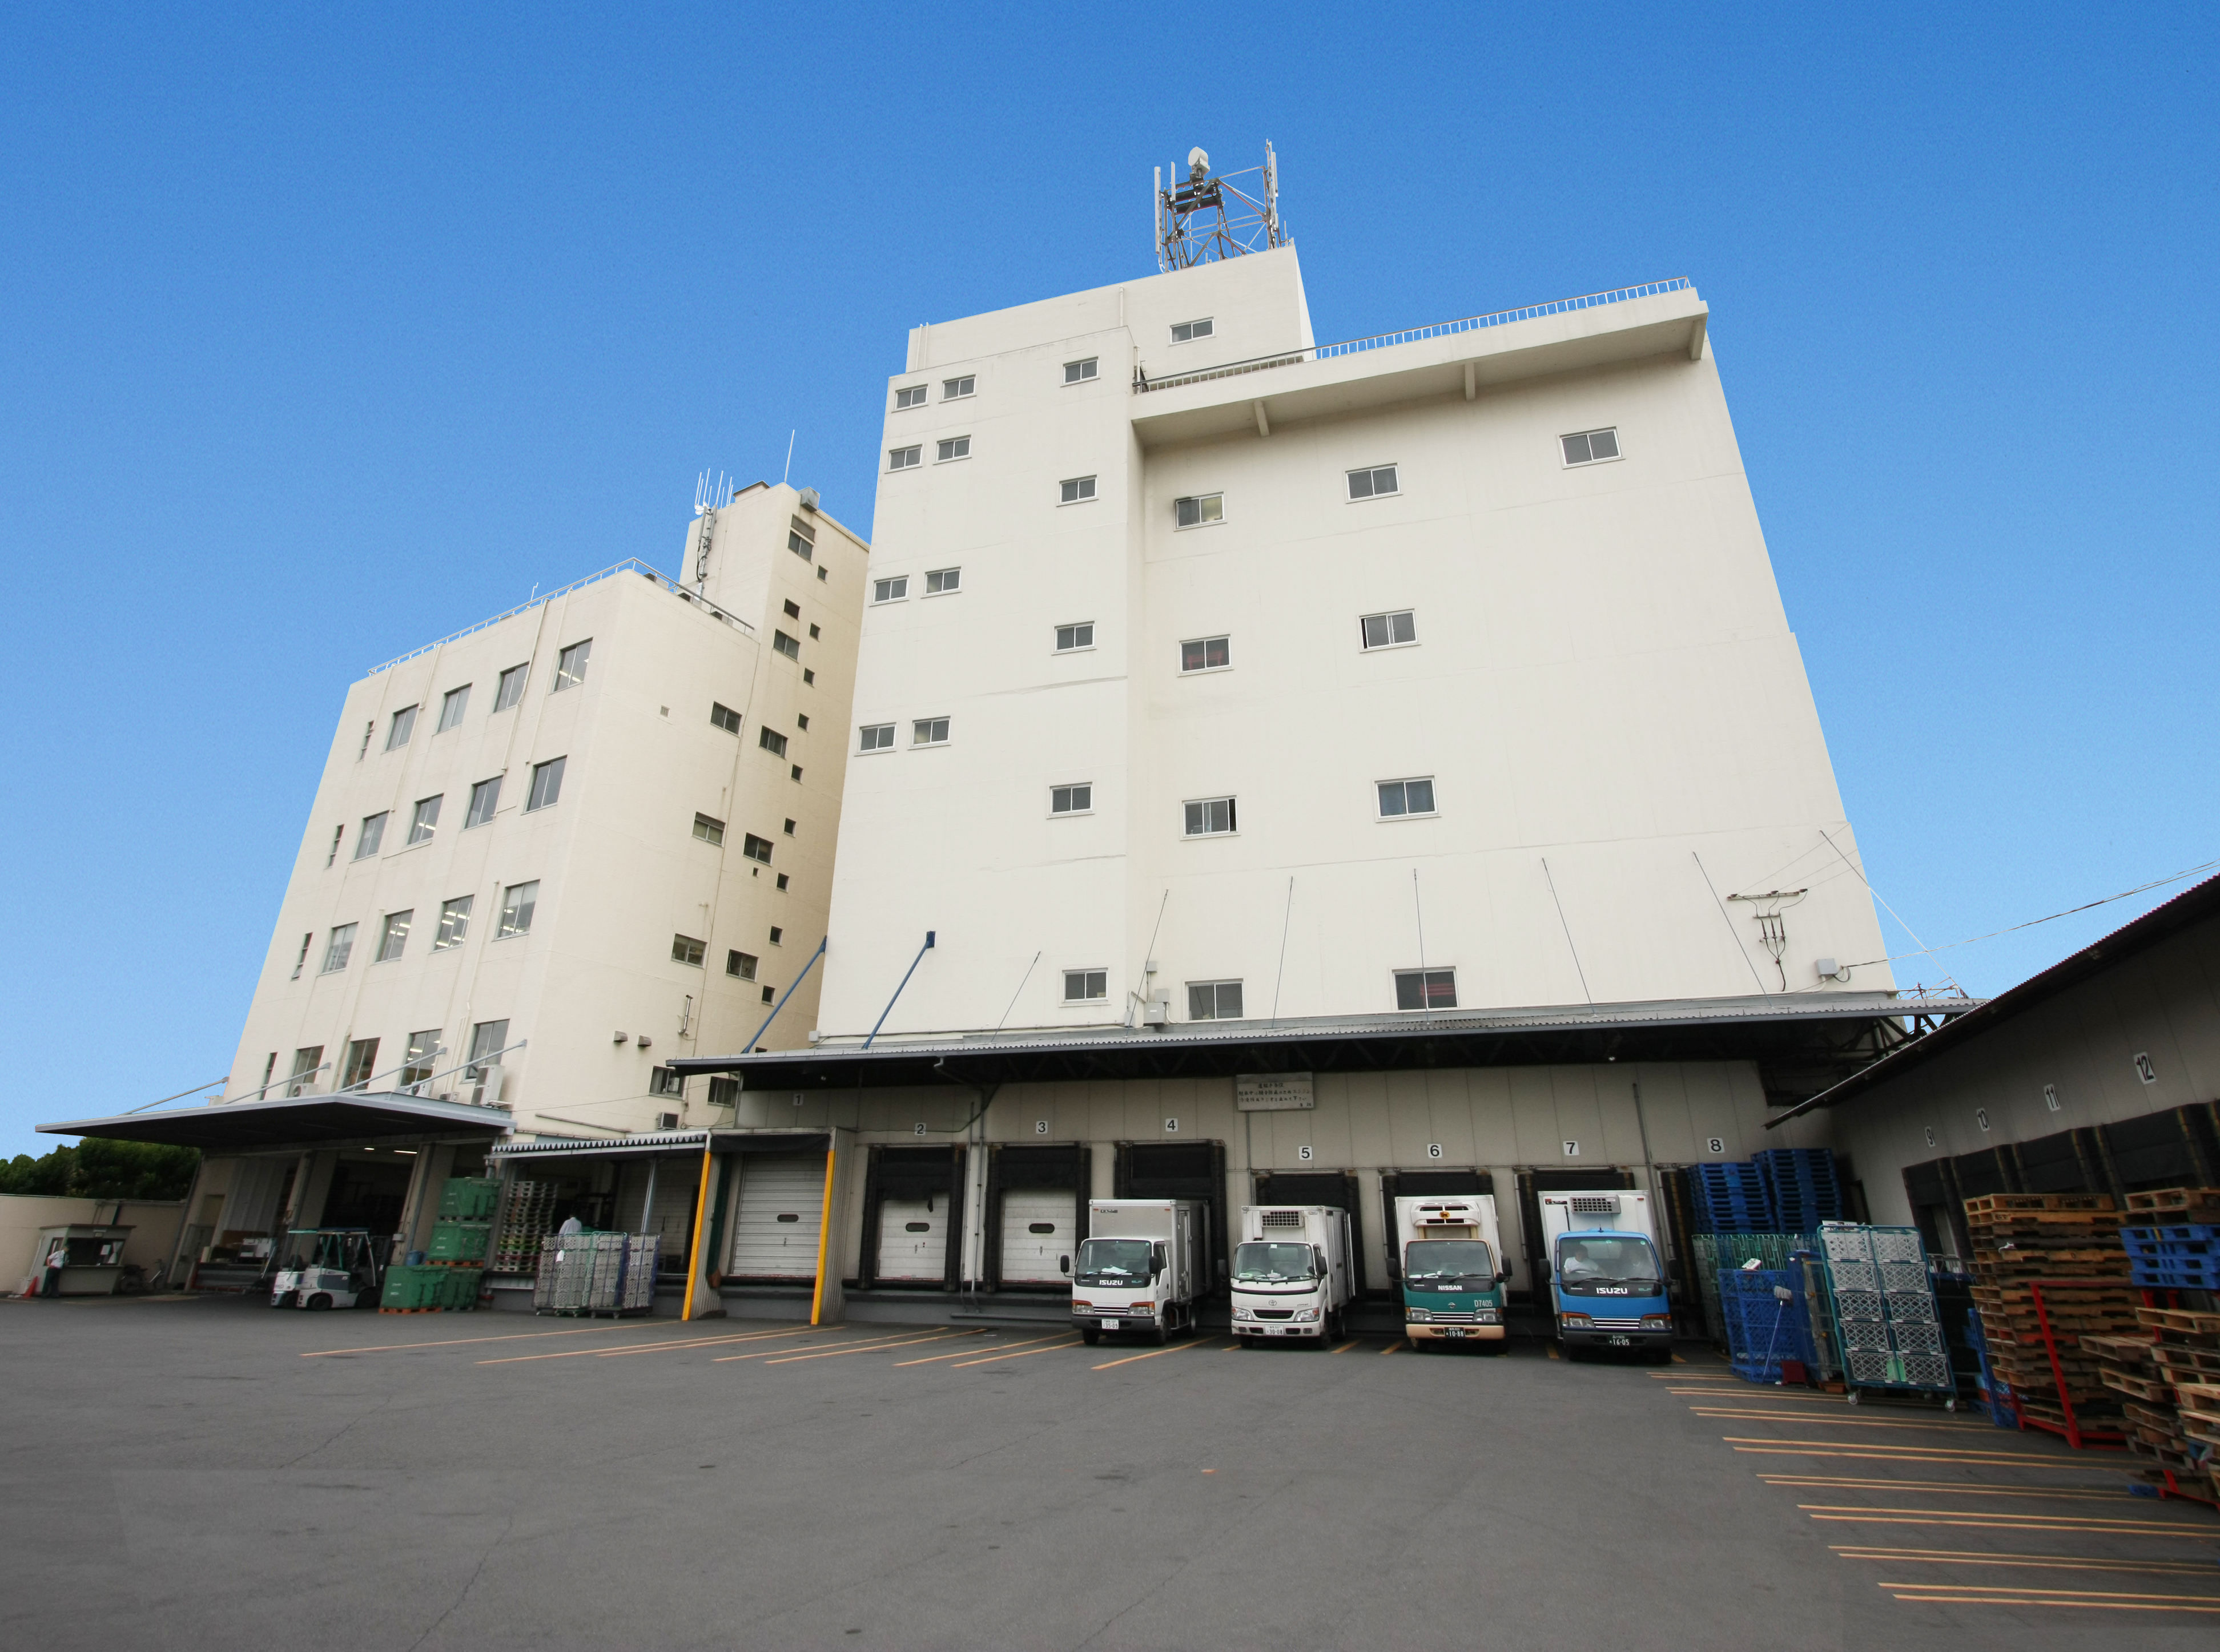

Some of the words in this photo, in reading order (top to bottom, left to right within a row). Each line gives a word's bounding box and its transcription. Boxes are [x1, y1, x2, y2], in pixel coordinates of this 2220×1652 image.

[2135, 1054, 2155, 1081] 12
[795, 1094, 801, 1105] 1
[2045, 1086, 2059, 1109] 11
[1168, 1119, 1176, 1131] 4
[1977, 1109, 1988, 1129] 10
[917, 1123, 924, 1134] 2
[1038, 1122, 1046, 1133] 3
[1927, 1128, 1933, 1145] 9
[1430, 1145, 1439, 1157] 6
[1566, 1142, 1575, 1154] 7
[1710, 1139, 1722, 1152] 8
[1301, 1147, 1310, 1159] 5
